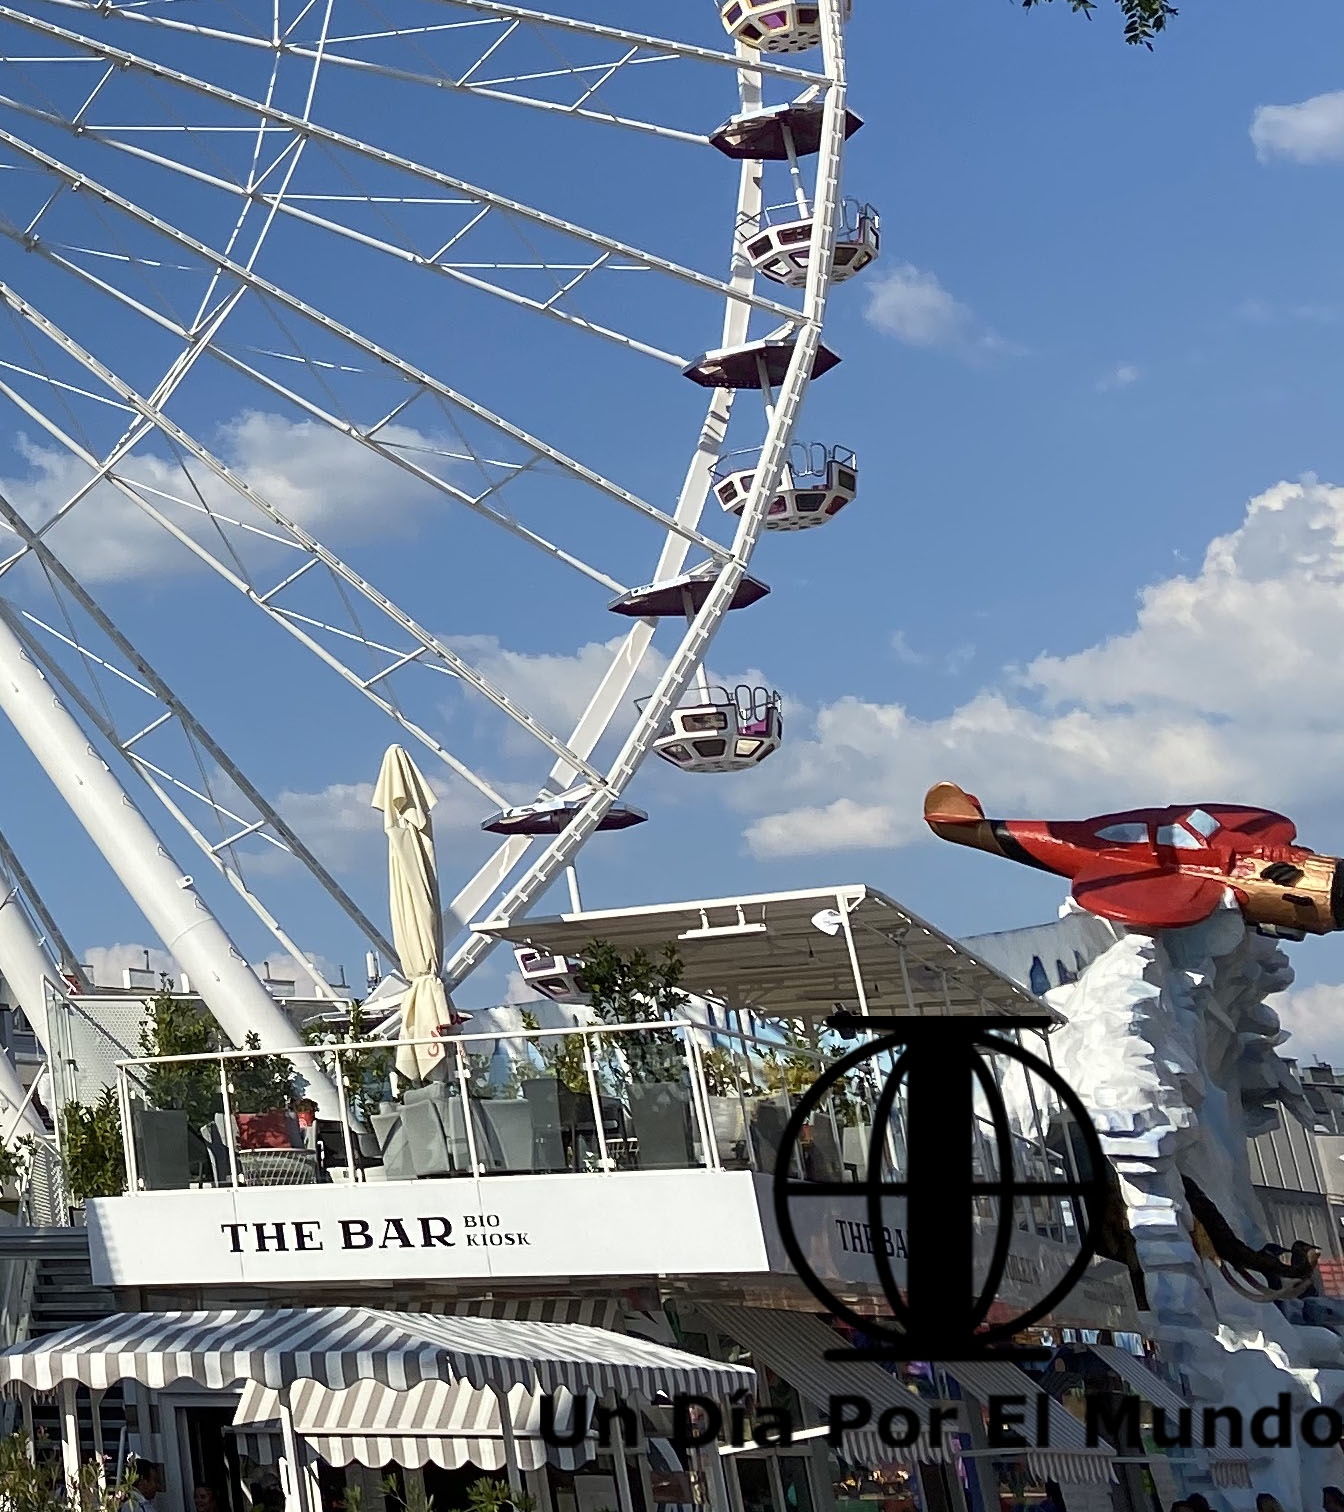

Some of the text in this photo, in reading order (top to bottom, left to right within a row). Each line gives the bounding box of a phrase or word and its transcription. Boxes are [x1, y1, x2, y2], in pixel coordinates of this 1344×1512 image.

[464, 1214, 500, 1228] BIO
[221, 1216, 456, 1252] THE BAR
[467, 1232, 532, 1247] KIOSK
